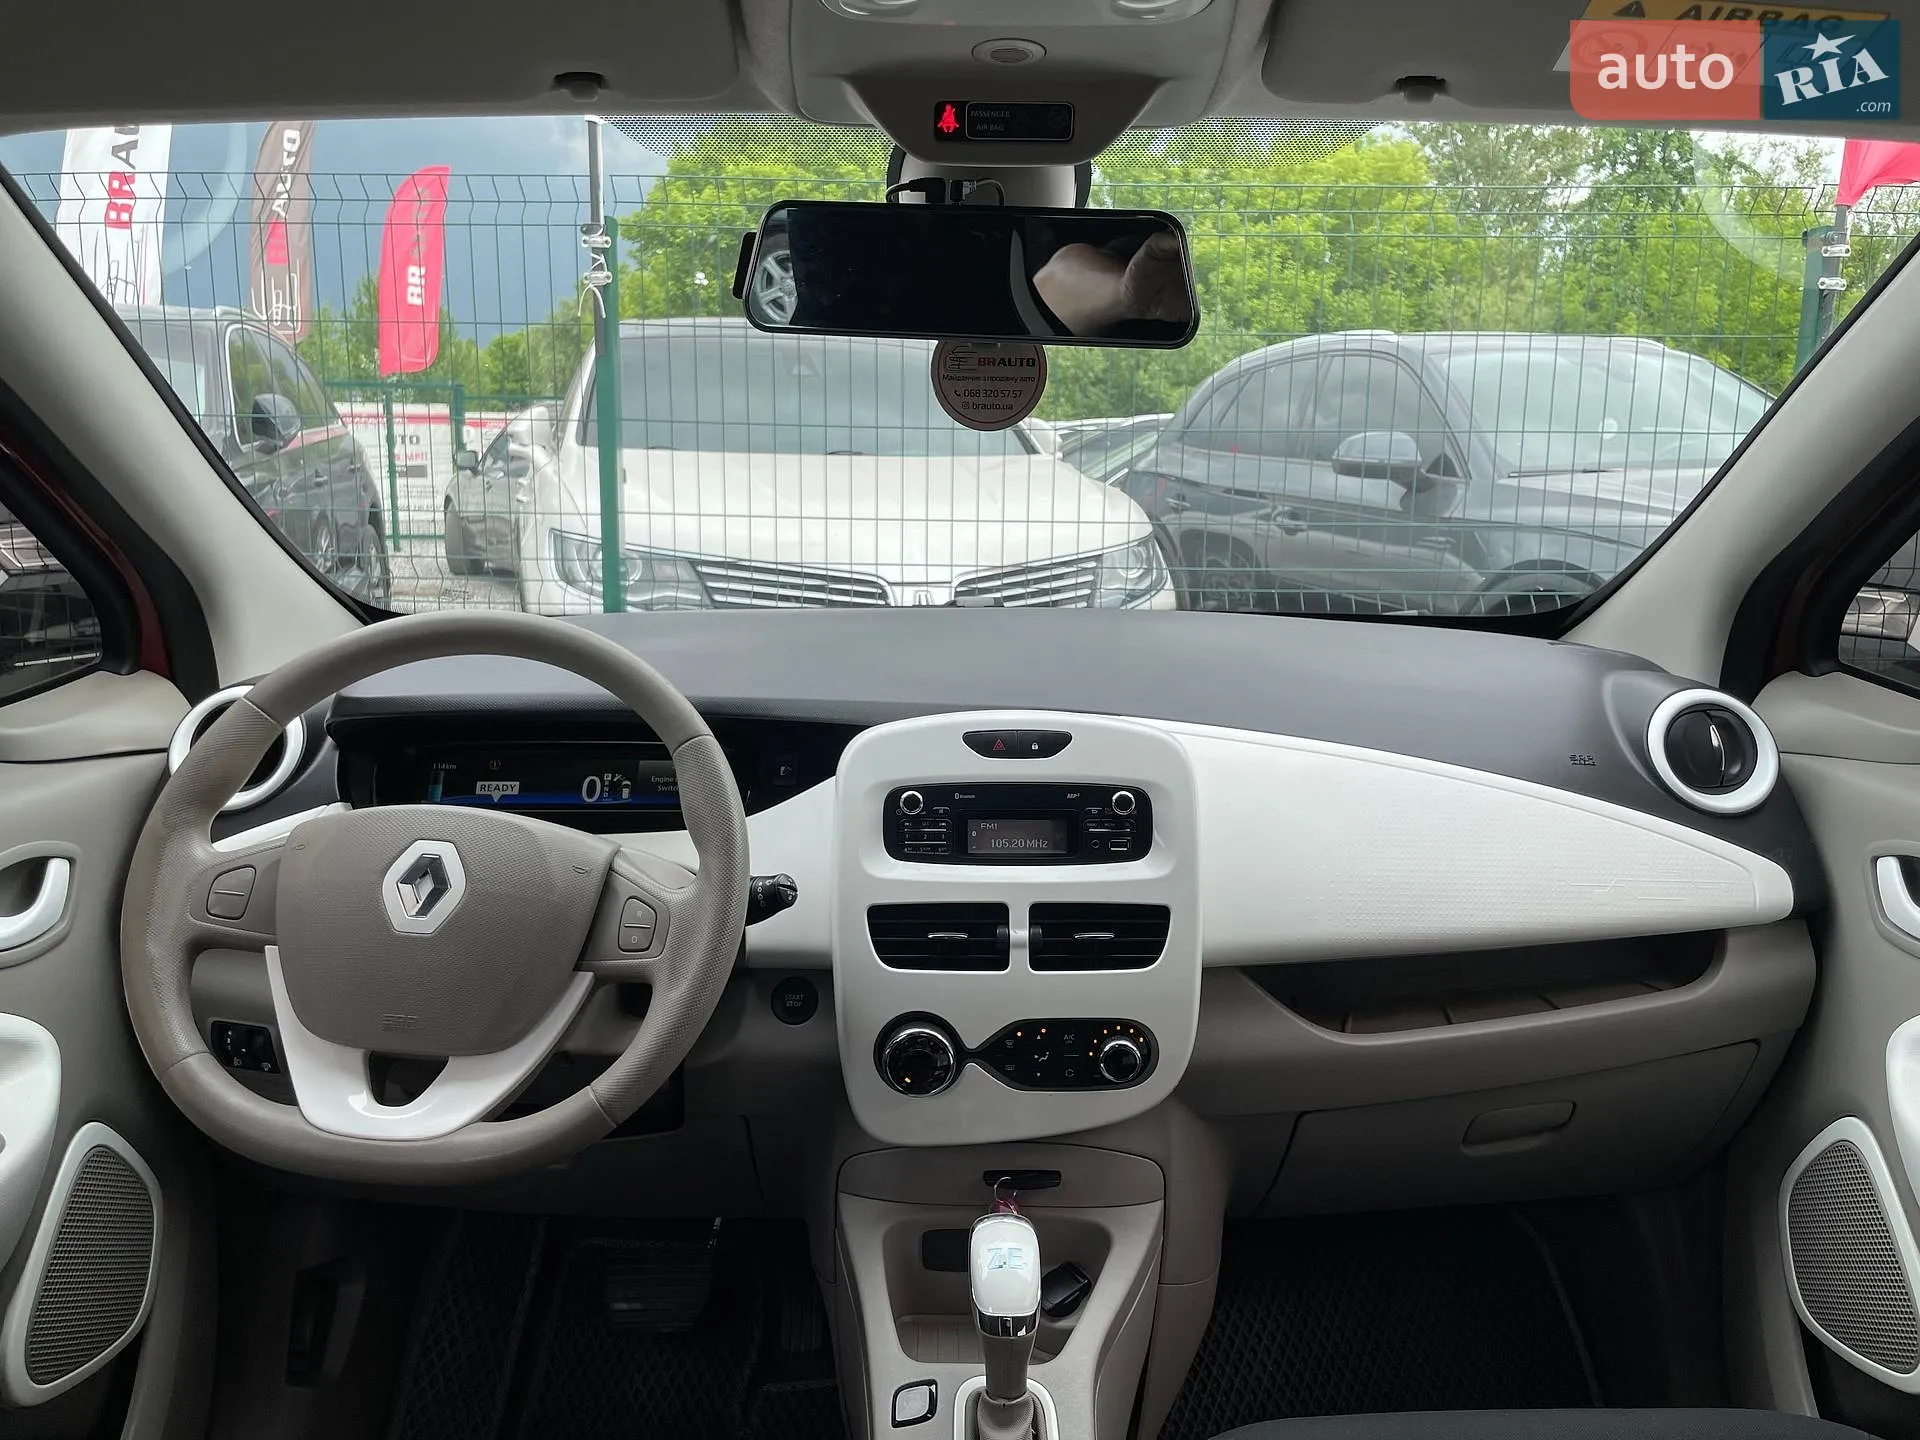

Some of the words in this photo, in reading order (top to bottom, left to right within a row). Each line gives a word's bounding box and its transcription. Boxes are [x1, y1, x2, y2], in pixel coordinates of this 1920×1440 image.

[970, 110, 1010, 118] PASSENGER
[977, 357, 1036, 368] BRAUTO
[963, 389, 981, 399] 068
[982, 389, 999, 399] 320
[1001, 389, 1011, 399] 57
[1012, 389, 1023, 399] 57
[972, 401, 1014, 411] brauto.ua
[651, 775, 675, 784] Engine
[480, 783, 517, 792] READY
[582, 775, 602, 803] 0
[981, 822, 998, 830] FM1
[991, 838, 1025, 848] 105.20
[1026, 839, 1048, 848] MHz
